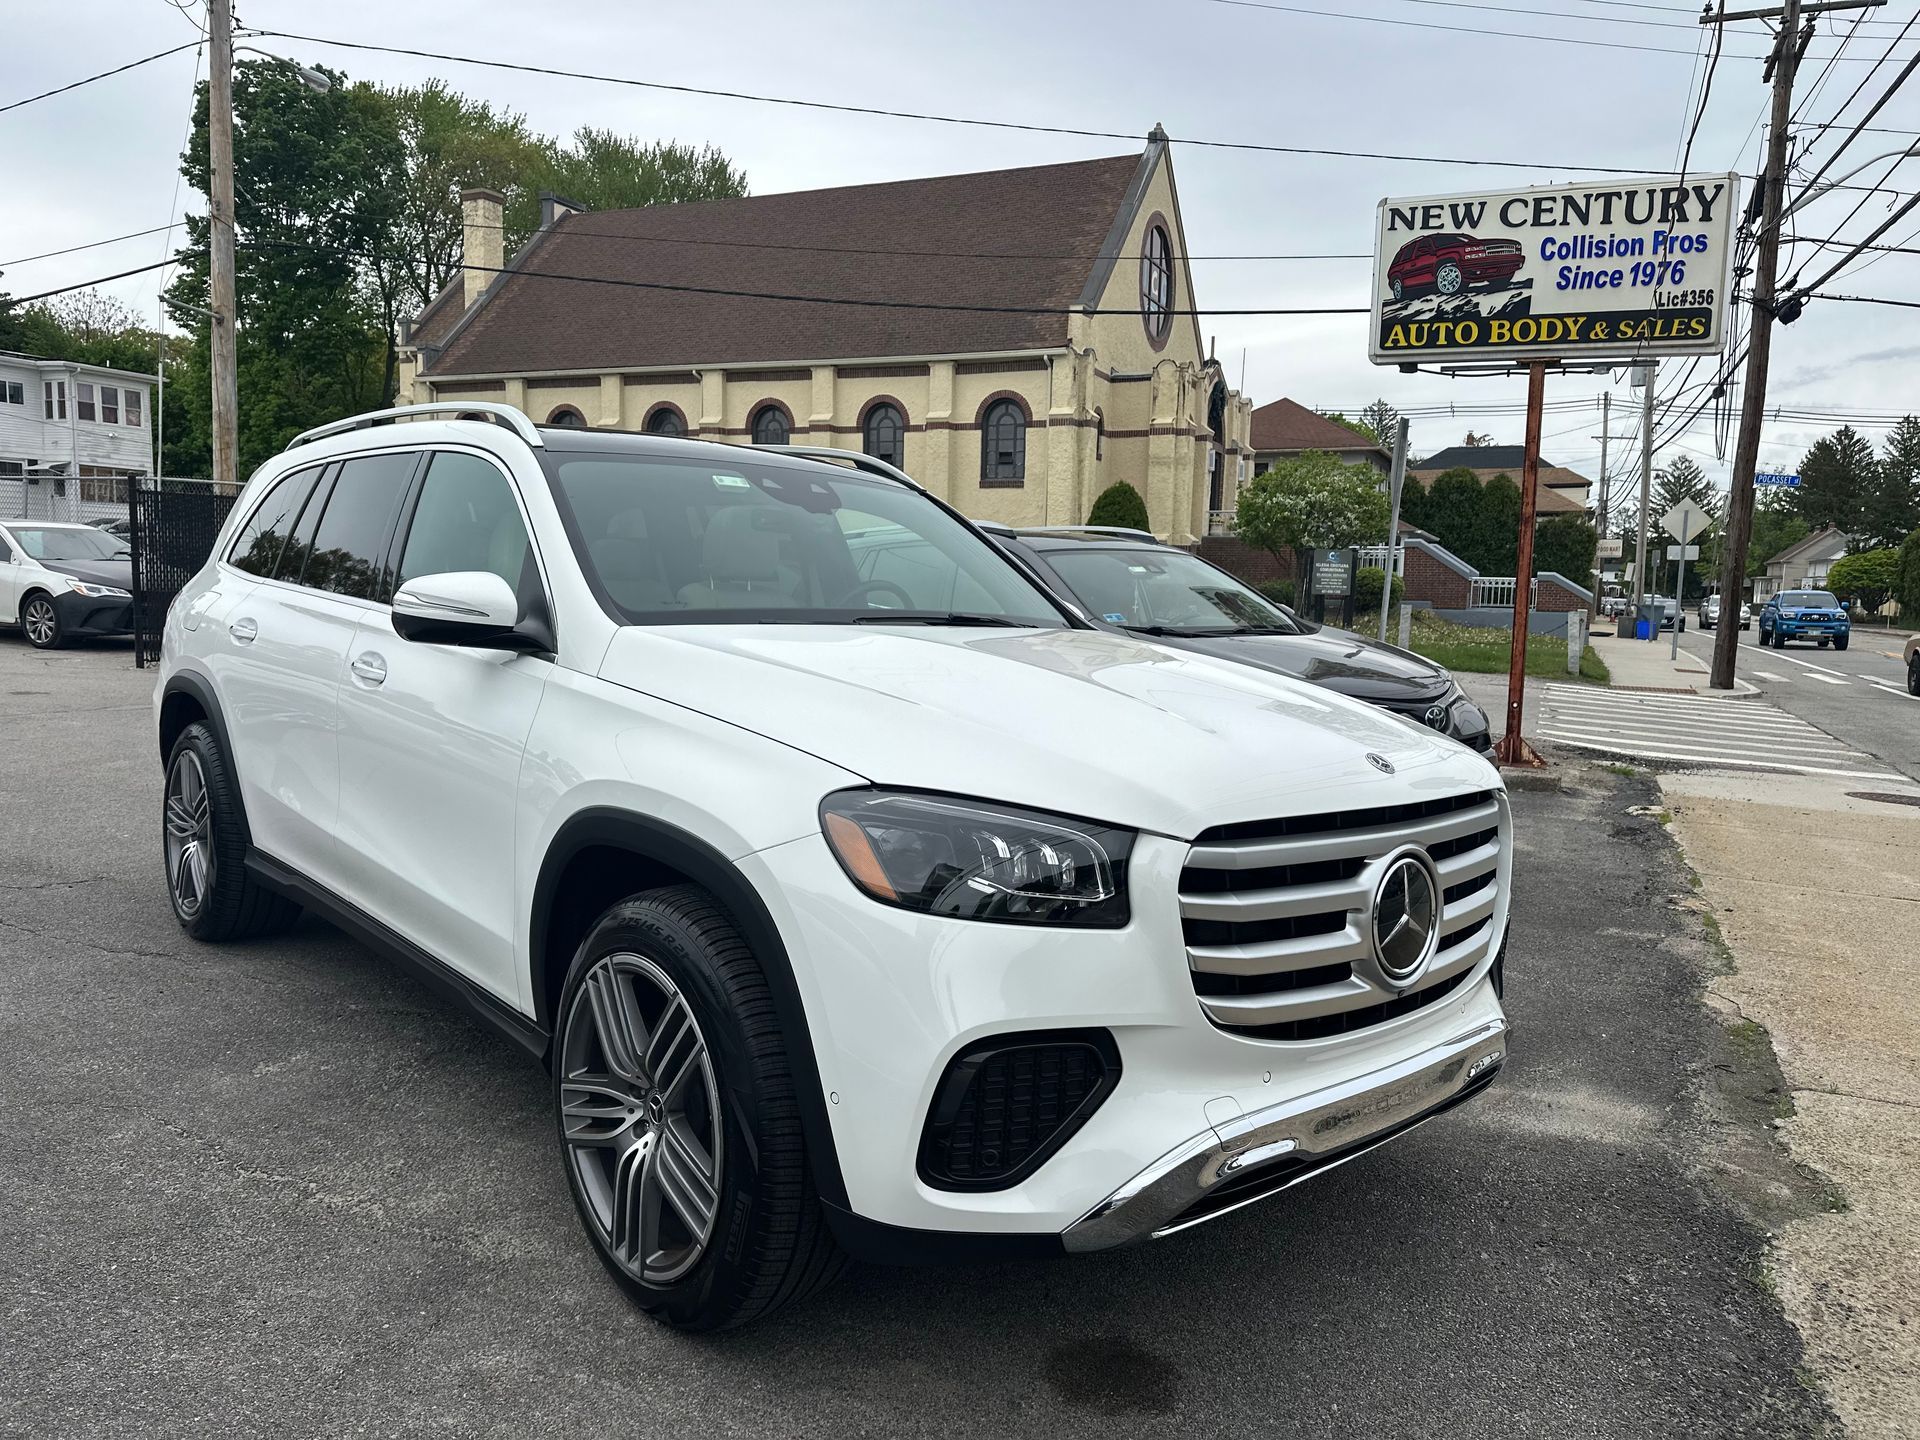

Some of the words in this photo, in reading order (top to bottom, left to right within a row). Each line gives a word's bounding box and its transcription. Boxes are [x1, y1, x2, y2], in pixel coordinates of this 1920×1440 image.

[1387, 201, 1487, 231] NEW
[1499, 184, 1725, 228] CENTURY
[1540, 233, 1644, 261] Collision
[1652, 230, 1708, 255] Pros
[1556, 265, 1624, 290] Since
[1629, 259, 1686, 287] 1976
[1658, 289, 1714, 307] Lic#356
[1384, 320, 1479, 349] AUTO
[1488, 316, 1588, 345] BODY
[1589, 320, 1610, 341] &
[1616, 317, 1706, 339] SALES
[1758, 475, 1792, 485] POCASSET
